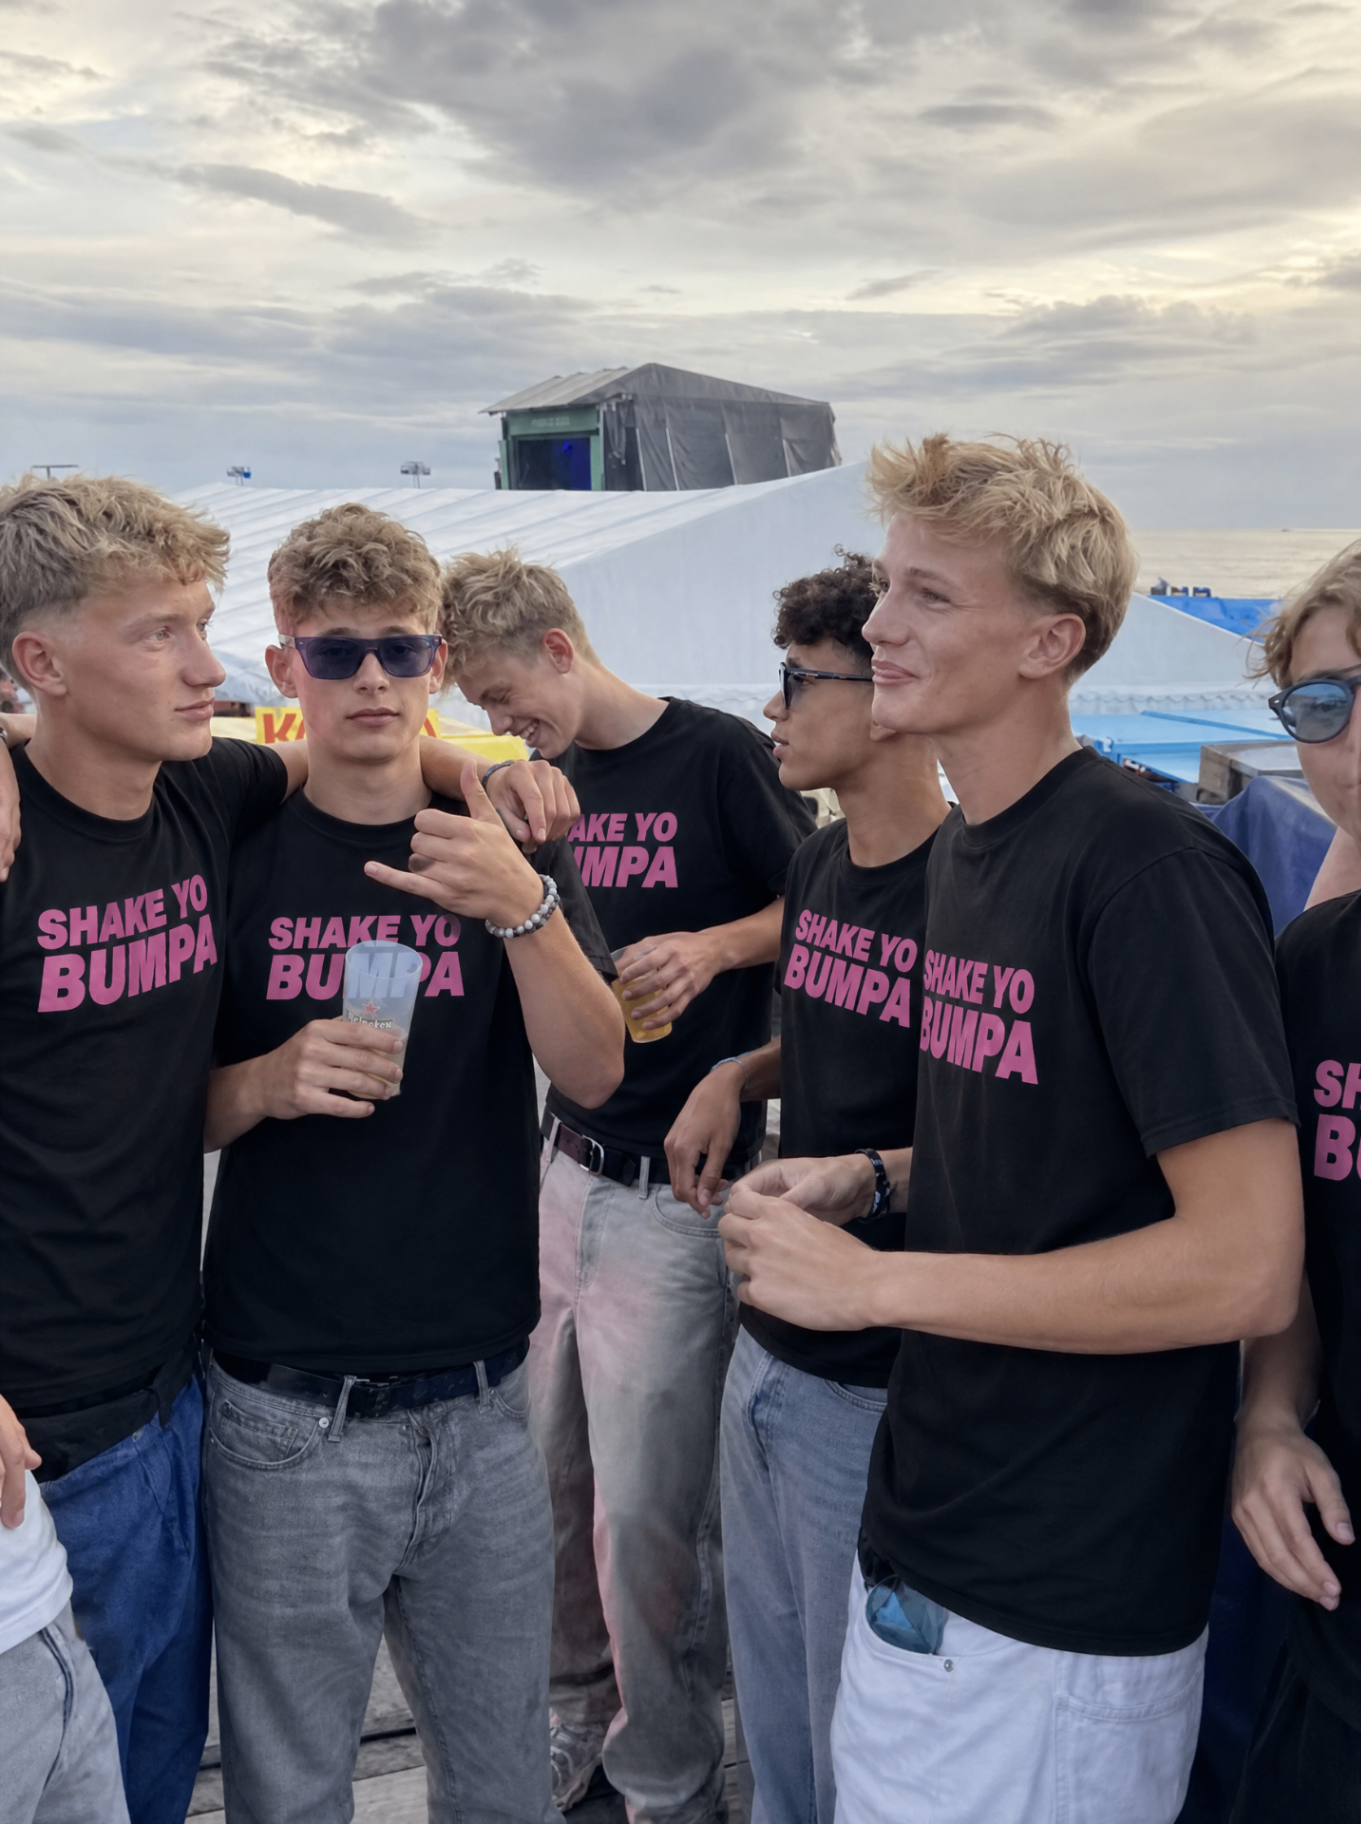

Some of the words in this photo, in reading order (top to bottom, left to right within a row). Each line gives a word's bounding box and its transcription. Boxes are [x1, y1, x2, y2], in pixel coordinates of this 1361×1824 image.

[565, 813, 628, 842] AKE
[635, 812, 678, 842] YO
[574, 846, 679, 888] MPA
[37, 888, 167, 950] SHAKE
[171, 874, 207, 919] YO
[268, 915, 401, 950] SHAKE
[410, 914, 461, 947] YO
[795, 909, 875, 962] SHAKE
[880, 933, 918, 973] YO
[38, 914, 218, 1013] BUMPA
[266, 951, 465, 1000] BUMPA
[784, 943, 910, 1028] BUMPA
[923, 949, 989, 1005] SHAKE
[993, 965, 1035, 1014] YO
[919, 995, 1039, 1085] BUMPA
